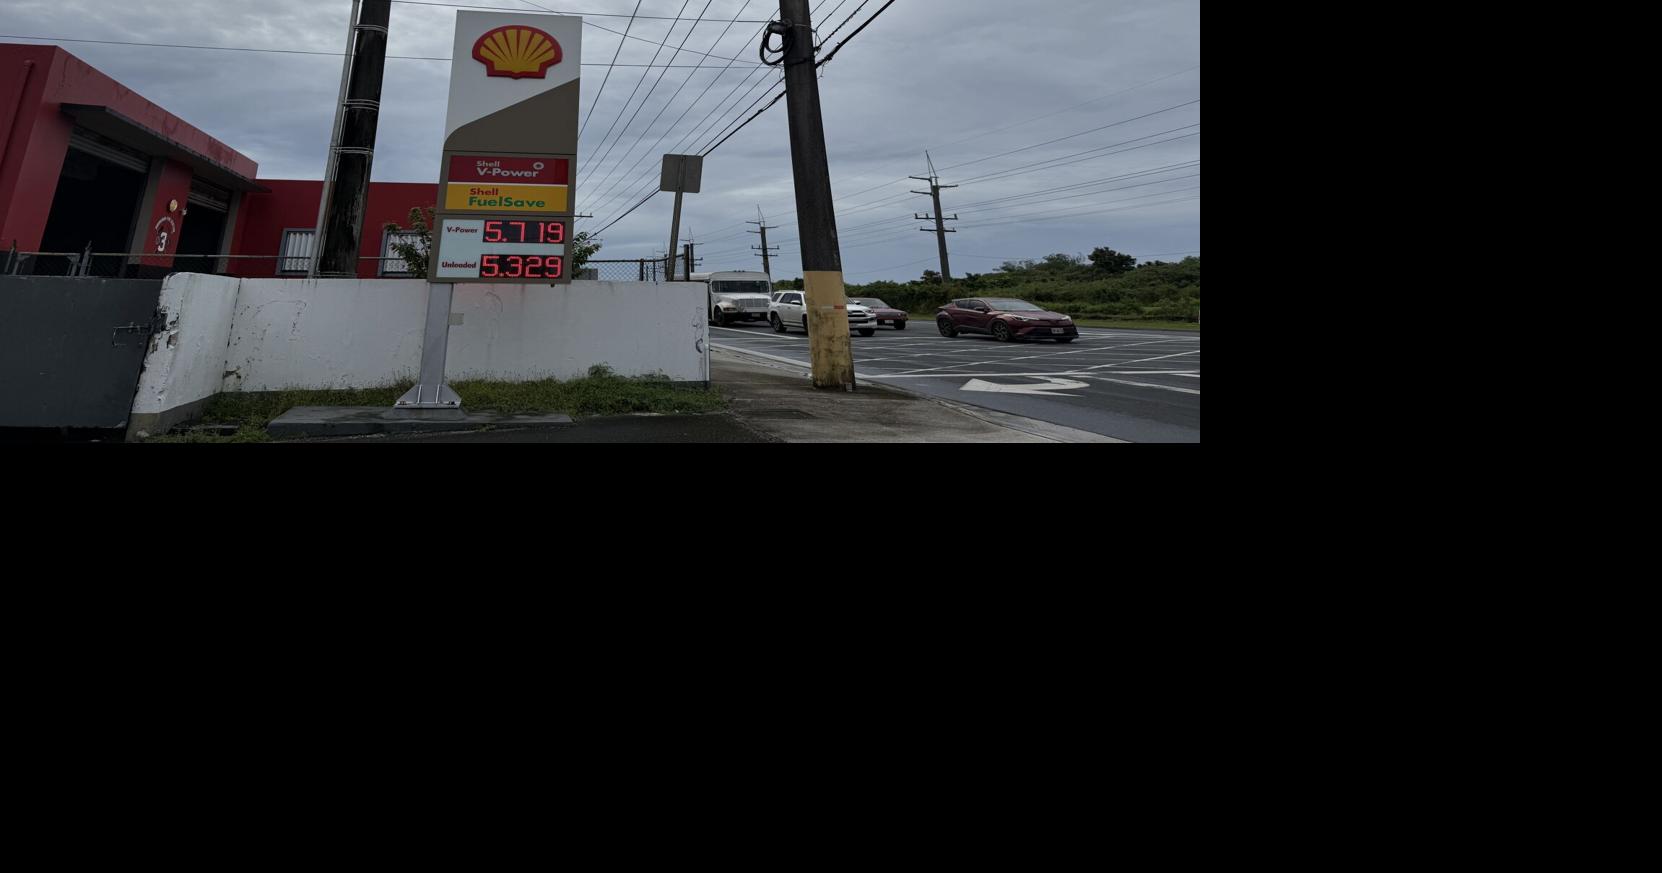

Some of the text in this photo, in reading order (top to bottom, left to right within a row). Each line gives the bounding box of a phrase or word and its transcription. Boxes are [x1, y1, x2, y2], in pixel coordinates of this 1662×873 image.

[476, 167, 539, 177] V-Power
[469, 188, 499, 196] Shell
[468, 196, 545, 208] FuelSave
[485, 221, 564, 243] 5.719
[158, 232, 168, 251] 3
[481, 255, 562, 278] 5.329
